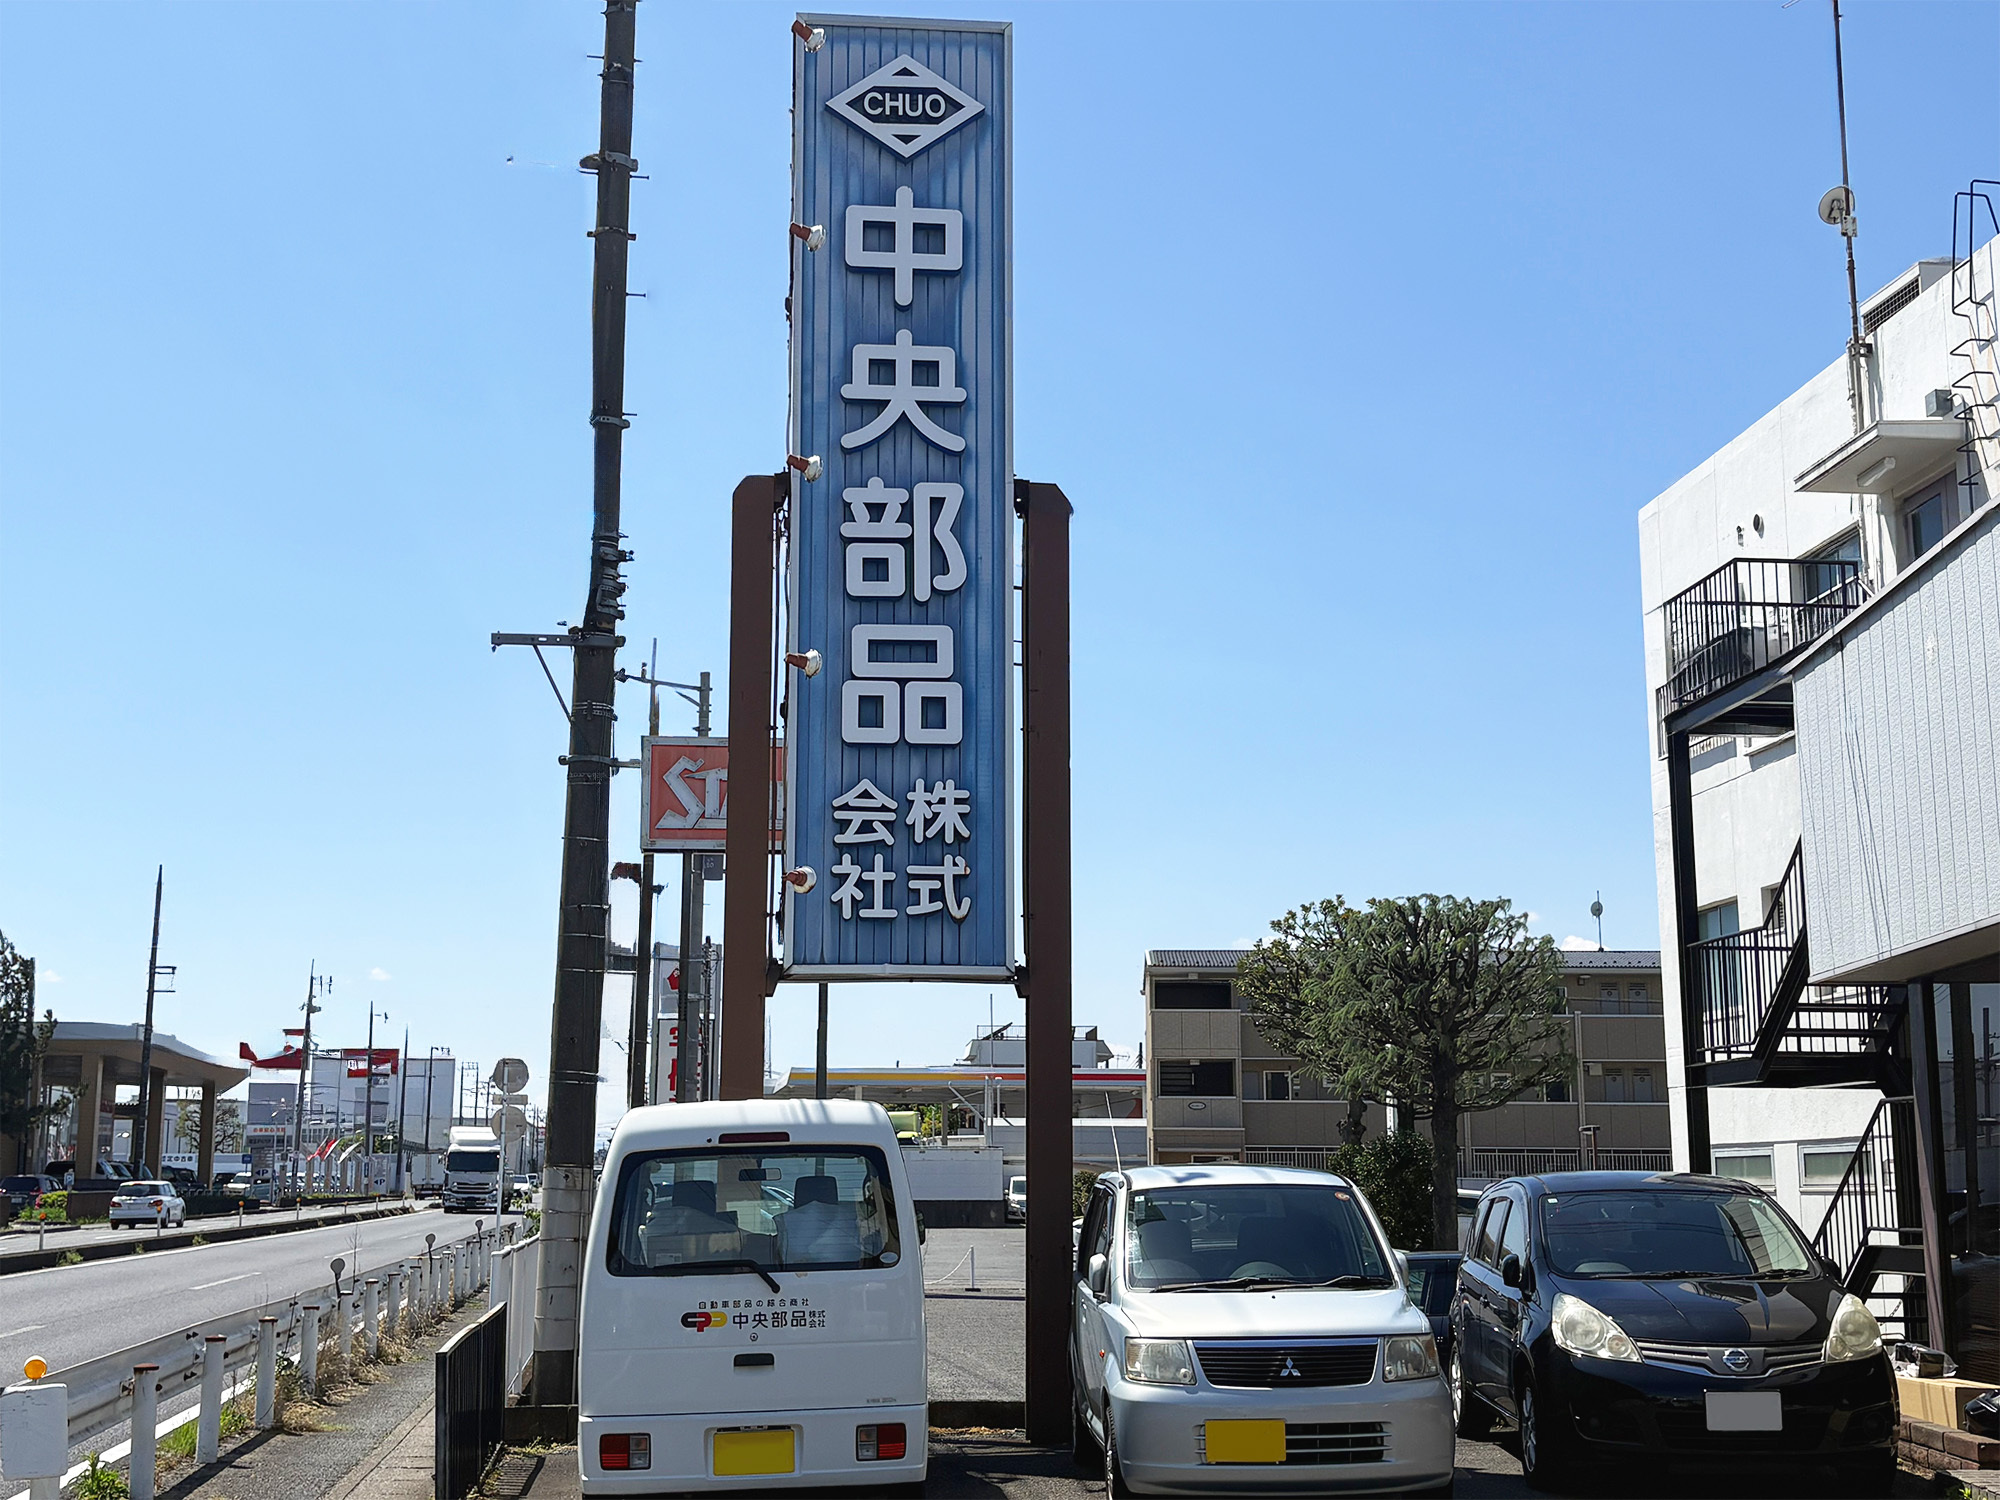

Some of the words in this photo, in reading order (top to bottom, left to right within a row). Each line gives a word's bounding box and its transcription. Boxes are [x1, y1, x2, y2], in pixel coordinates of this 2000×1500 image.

[863, 91, 946, 118] CHUO
[840, 186, 967, 744] 中央部品
[732, 1310, 807, 1330] 中央部品
